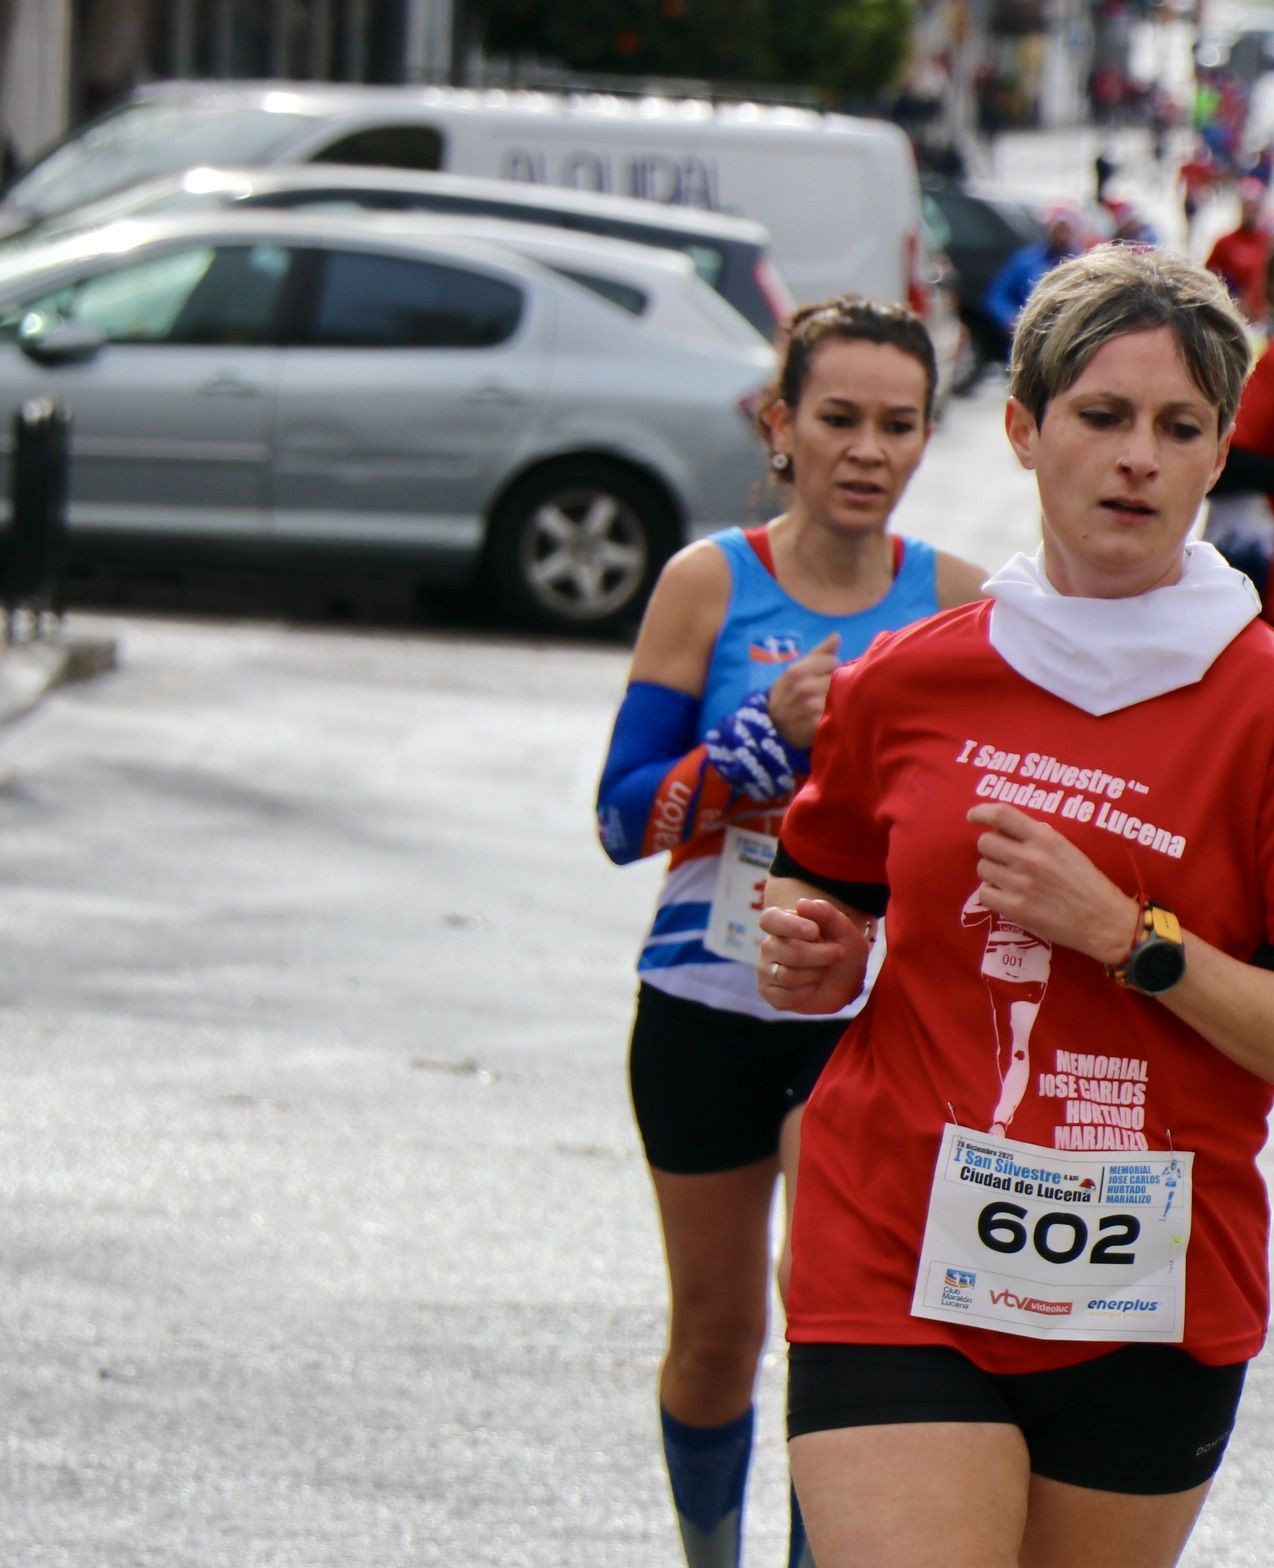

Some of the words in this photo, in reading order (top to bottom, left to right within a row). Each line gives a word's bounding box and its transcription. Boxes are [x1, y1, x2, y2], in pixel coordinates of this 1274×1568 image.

[956, 739, 978, 764] I
[974, 744, 1021, 774] San
[1020, 752, 1126, 799] Silvestre
[976, 774, 1064, 814] Ciudad
[1061, 794, 1095, 823] de
[1095, 802, 1187, 859] Lucena
[1002, 953, 1023, 968] 001
[1056, 1049, 1149, 1082] MEMORIAL
[1039, 1073, 1078, 1098] JOSE
[1079, 1078, 1147, 1105] CARLOS
[1066, 1099, 1145, 1130] HURTADO
[1054, 1125, 1149, 1151] MARJALIZO
[998, 1150, 1014, 1161] 2025
[954, 1147, 963, 1162] I
[965, 1150, 992, 1170] San
[994, 1157, 1061, 1184] Silvestre
[1109, 1165, 1151, 1175] MEMORIAL
[960, 1166, 1011, 1191] Ciudad
[1014, 1180, 1034, 1195] de
[1037, 1183, 1091, 1203] Lucena
[1108, 1175, 1129, 1184] JOSE
[1130, 1174, 1160, 1184] CARLOS
[1107, 1185, 1147, 1194] HURTADO
[1106, 1195, 1152, 1204] MARJALIZO
[977, 1201, 1141, 1265] 602
[943, 1286, 961, 1295] Club
[941, 1300, 969, 1310] Lucena
[942, 1292, 973, 1304] Maratón
[1031, 1302, 1069, 1313] videoluc
[1087, 1299, 1159, 1312] enerplus
